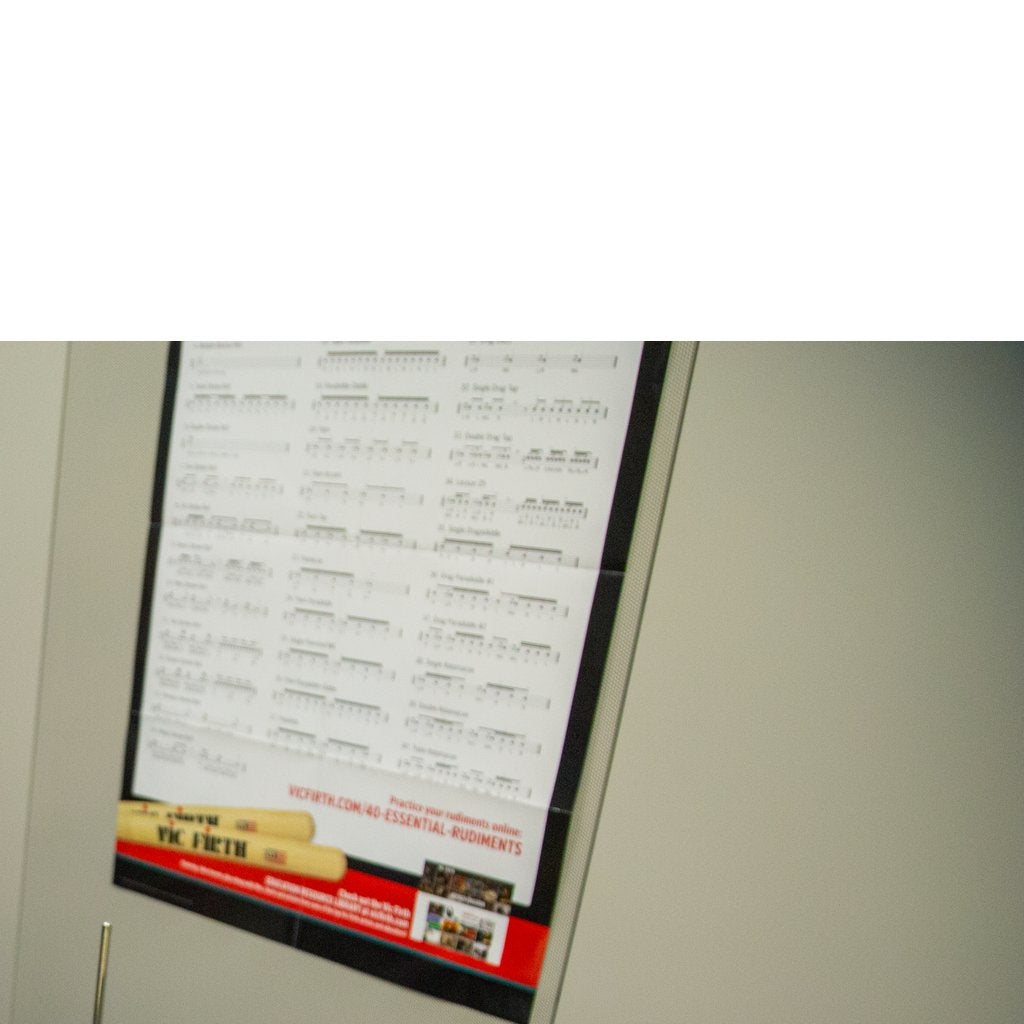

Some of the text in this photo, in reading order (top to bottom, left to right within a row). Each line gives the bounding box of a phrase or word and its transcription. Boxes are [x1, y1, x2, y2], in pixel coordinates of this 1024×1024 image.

[389, 794, 425, 812] Practice
[425, 803, 445, 818] your
[446, 809, 489, 829] rudiments
[192, 824, 247, 858] FIRTH
